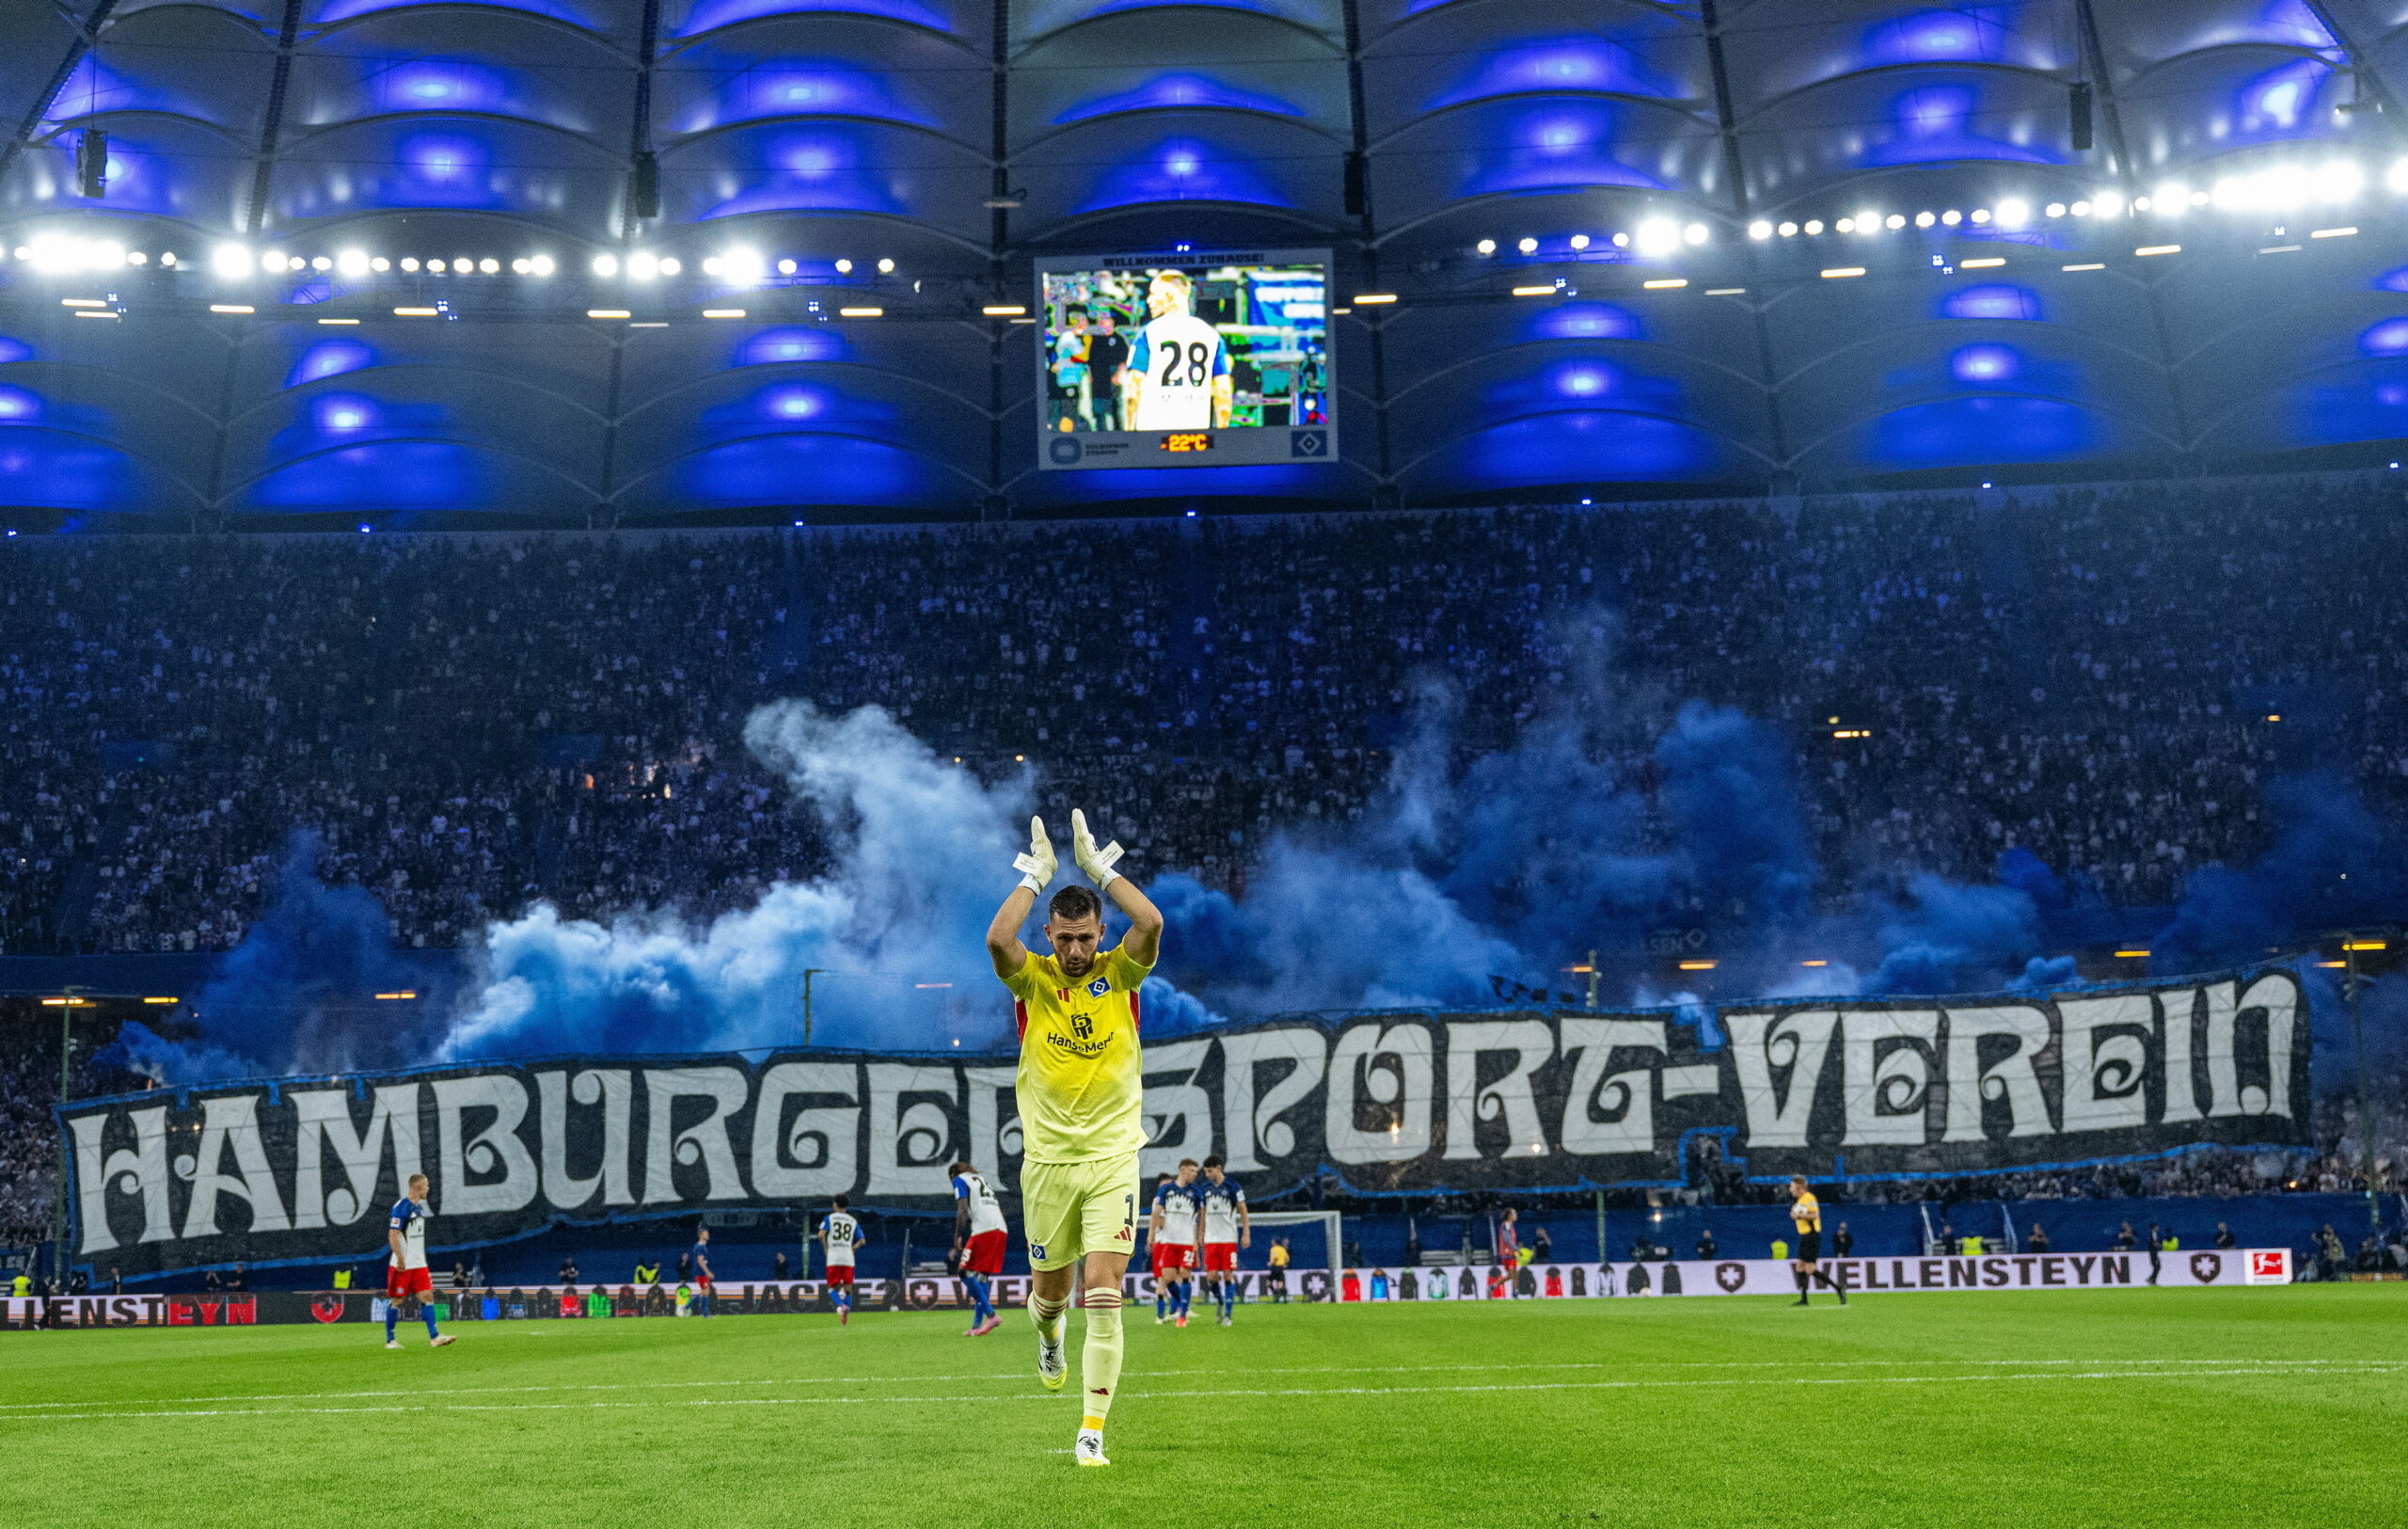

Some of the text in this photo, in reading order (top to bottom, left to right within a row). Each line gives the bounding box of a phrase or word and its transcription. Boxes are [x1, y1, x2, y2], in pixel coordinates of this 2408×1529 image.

[1160, 340, 1209, 387] 28
[1123, 1193, 1134, 1227] 1
[832, 1221, 852, 1242] 38
